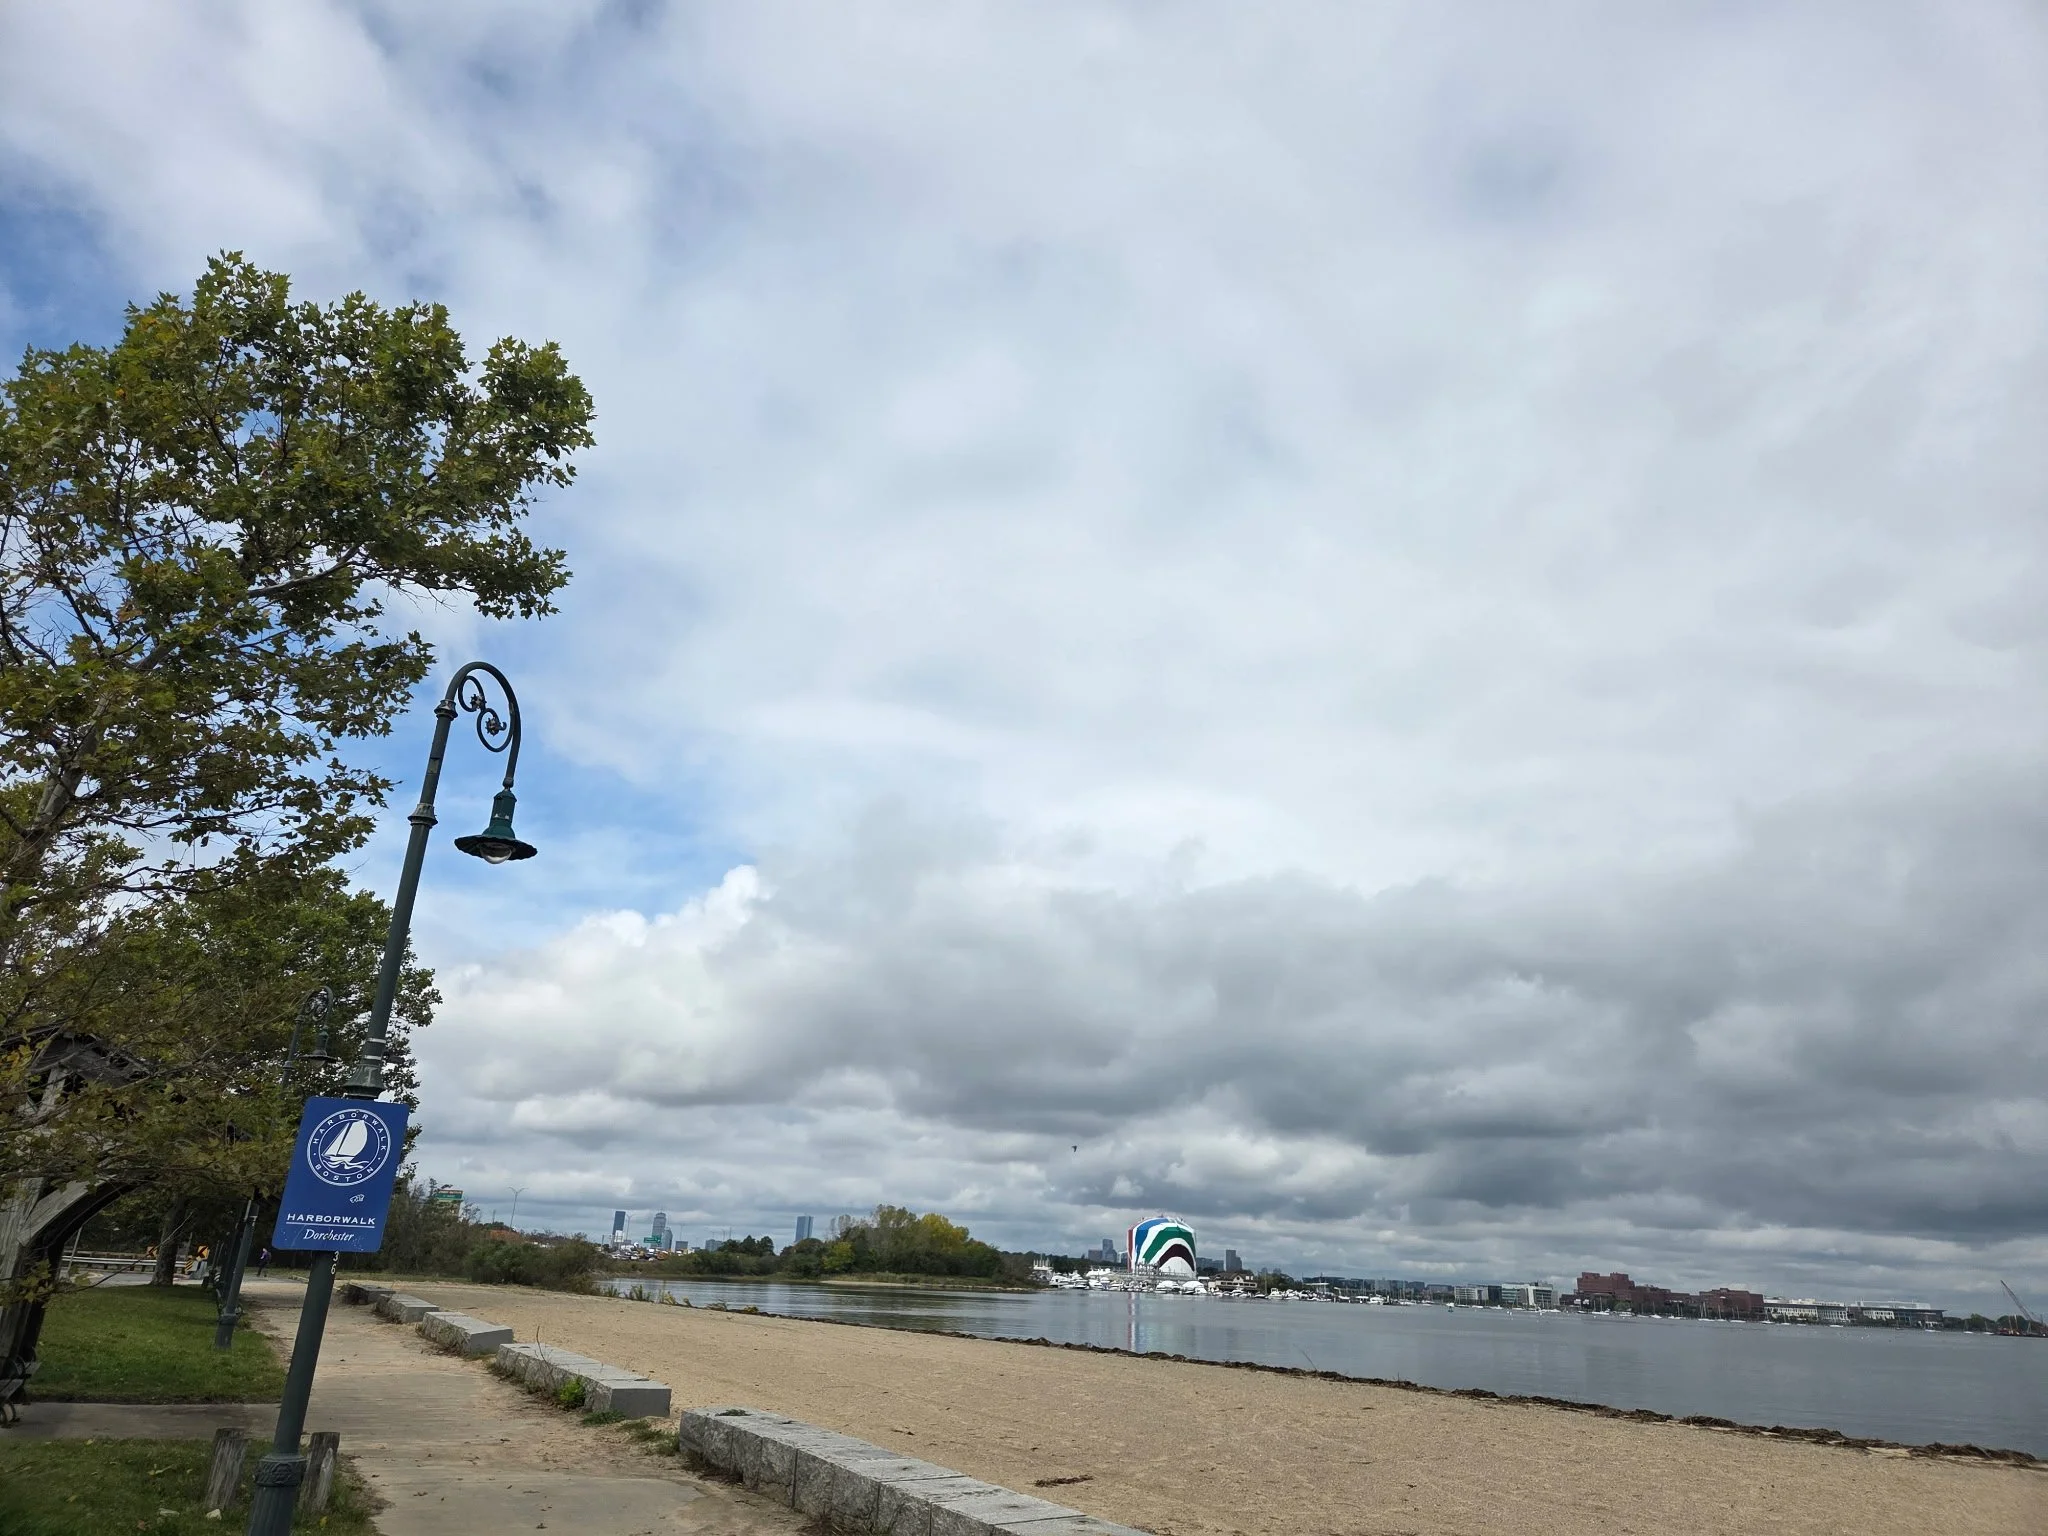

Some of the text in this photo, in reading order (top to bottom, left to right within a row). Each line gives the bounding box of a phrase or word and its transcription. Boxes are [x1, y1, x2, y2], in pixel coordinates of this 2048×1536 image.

[313, 1112, 387, 1151] HARBORWALK
[314, 1163, 374, 1182] BOSTON
[286, 1213, 376, 1225] HARBORWALK
[303, 1228, 355, 1241] Dorchester
